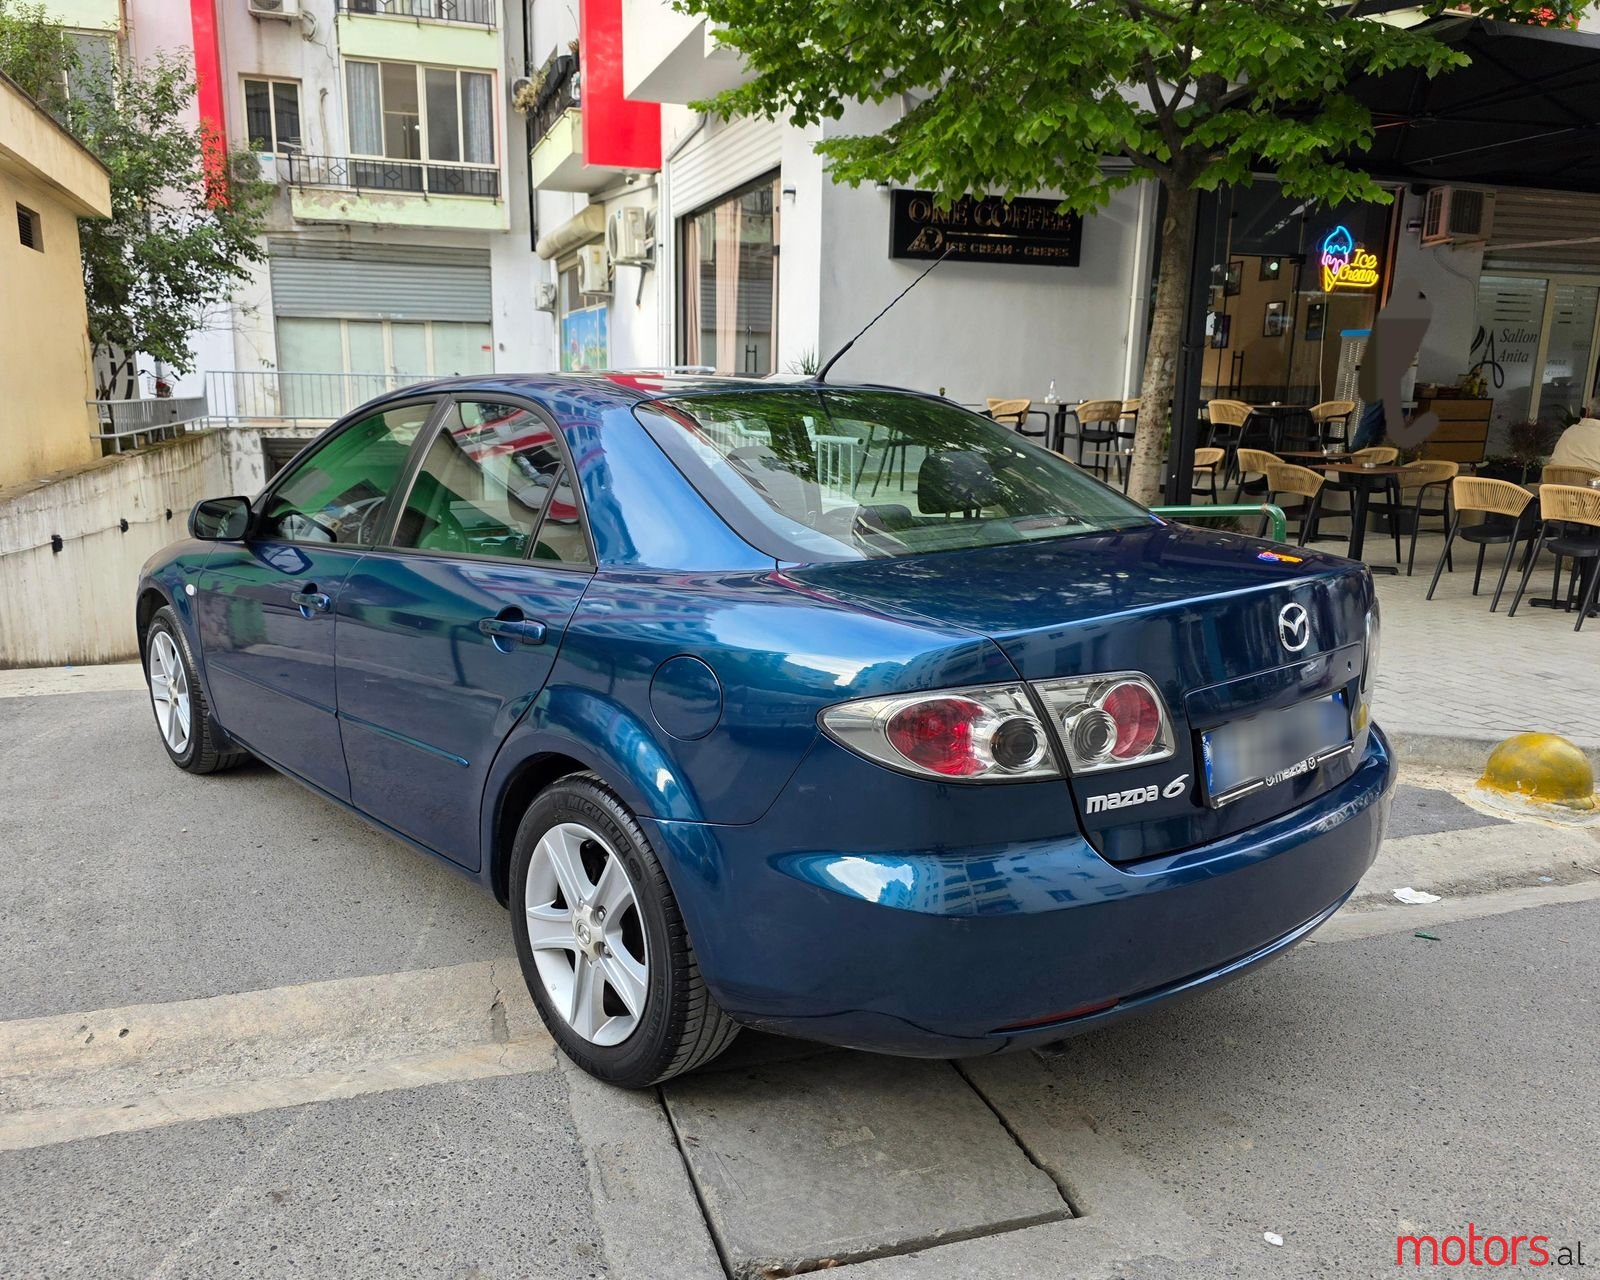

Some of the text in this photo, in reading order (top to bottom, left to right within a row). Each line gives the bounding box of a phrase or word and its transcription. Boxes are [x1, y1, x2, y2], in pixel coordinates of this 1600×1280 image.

[908, 199, 1072, 232] ONE COFFEE
[970, 243, 1013, 255] CREAM
[1350, 248, 1377, 269] Ice
[1340, 264, 1378, 286] Cream
[1496, 349, 1529, 363] Anita
[1162, 774, 1189, 799] 6
